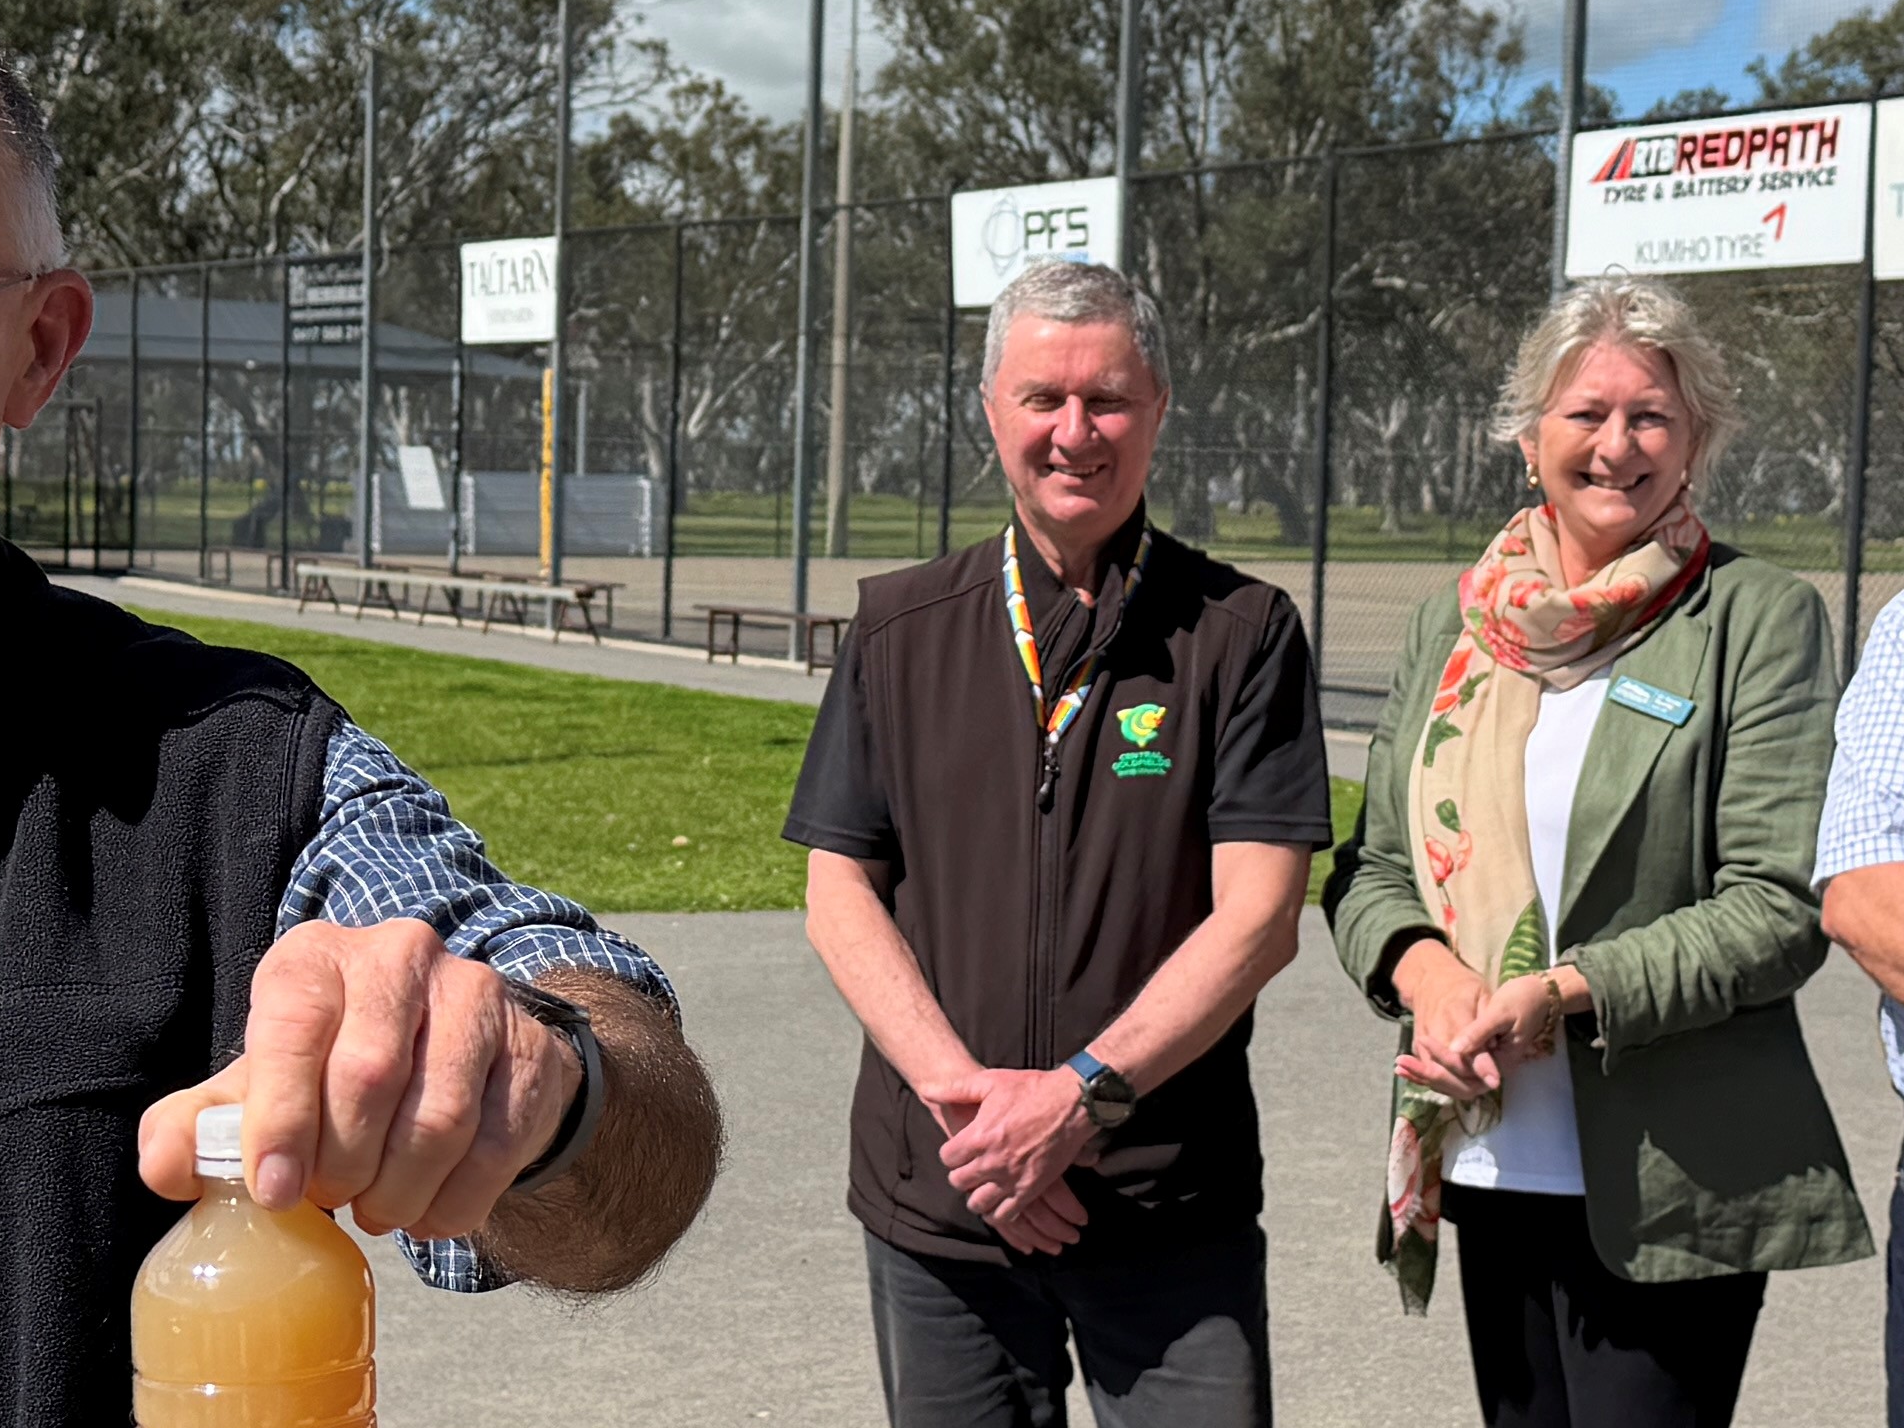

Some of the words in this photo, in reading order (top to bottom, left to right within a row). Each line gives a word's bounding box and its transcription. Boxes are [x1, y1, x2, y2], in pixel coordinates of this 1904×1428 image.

[1675, 117, 1840, 175] REDPATH
[1604, 186, 1646, 204] TYRE
[1672, 174, 1752, 199] BATTERY
[1759, 167, 1837, 192] SERVICE
[1024, 207, 1089, 250] PFS
